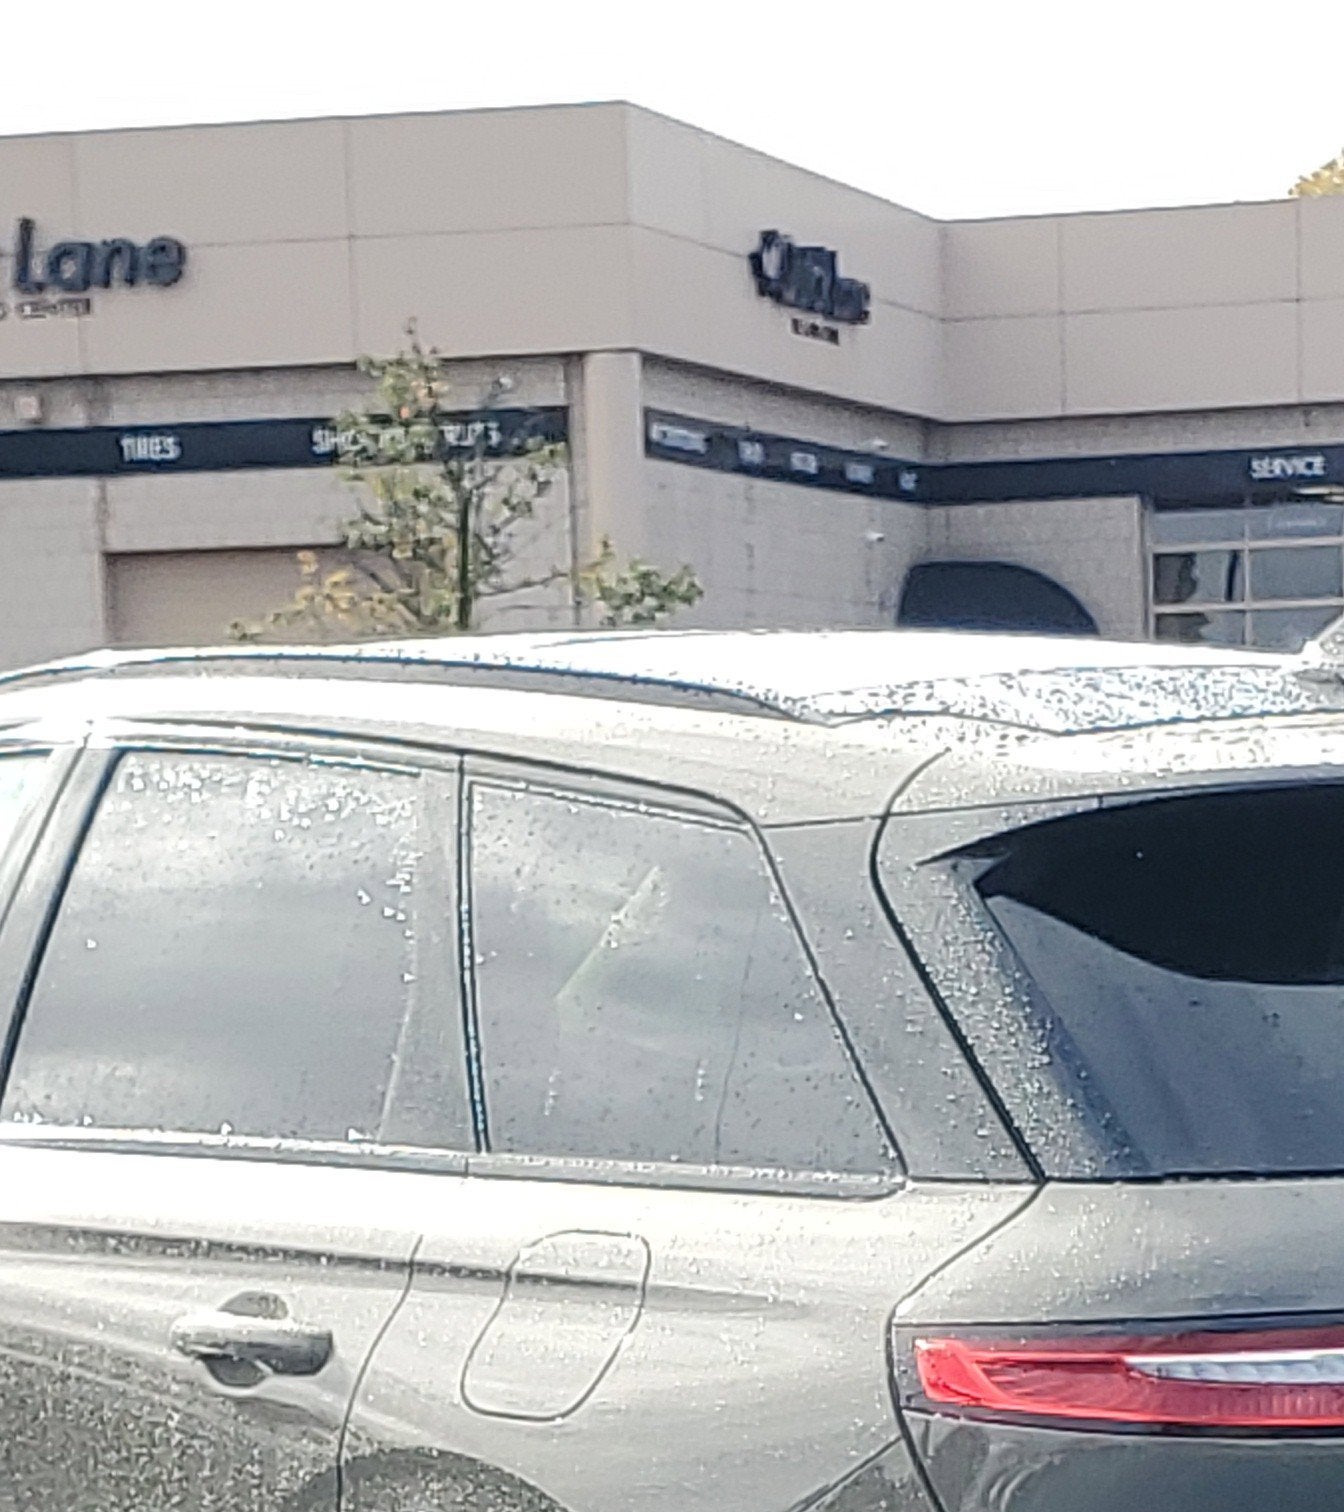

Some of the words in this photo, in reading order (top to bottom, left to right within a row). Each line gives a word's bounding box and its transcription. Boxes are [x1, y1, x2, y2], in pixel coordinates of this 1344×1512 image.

[15, 217, 187, 294] Lane
[120, 434, 182, 461] TIRES
[1250, 453, 1325, 479] SERVICE
